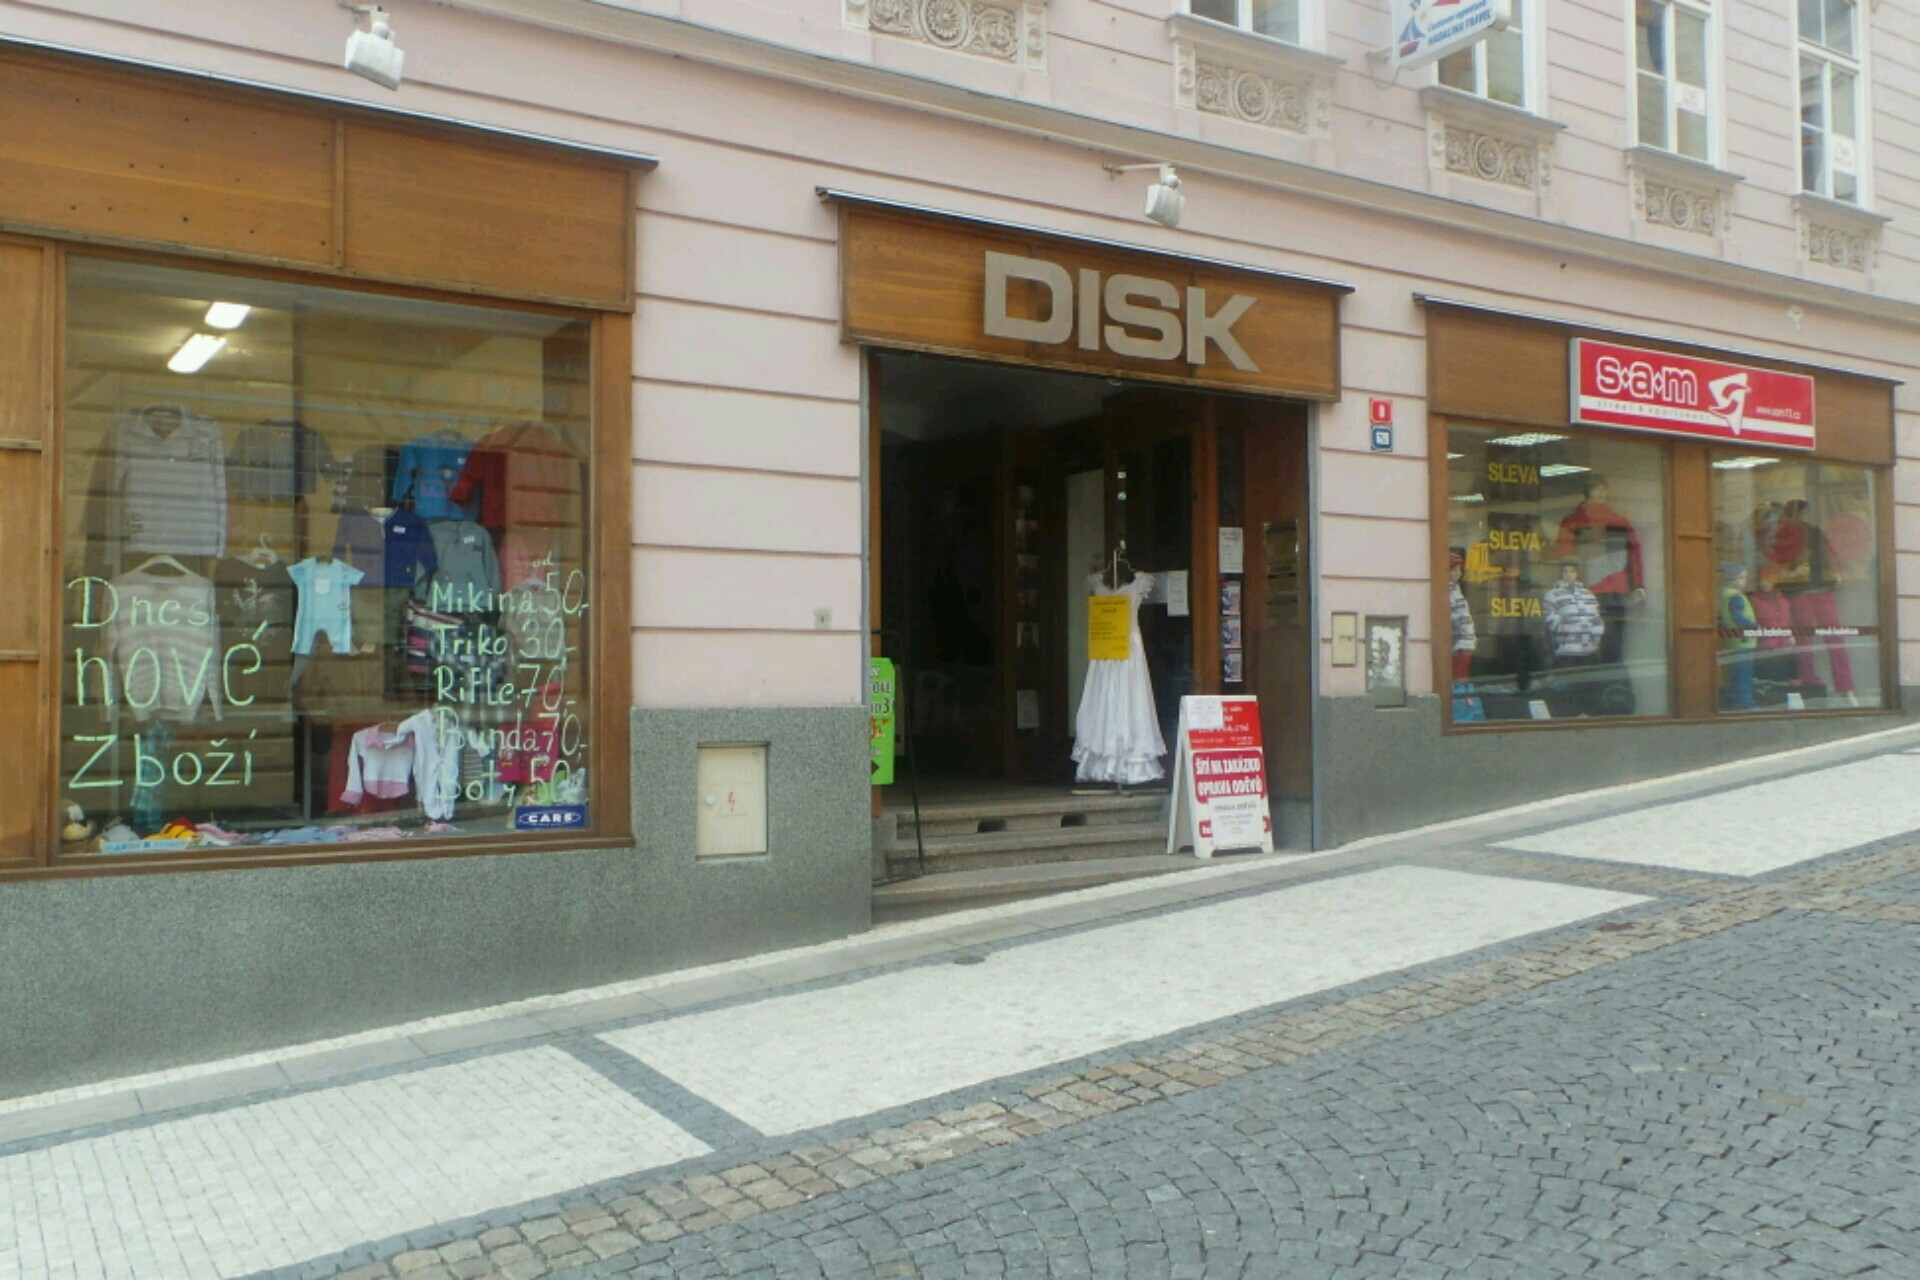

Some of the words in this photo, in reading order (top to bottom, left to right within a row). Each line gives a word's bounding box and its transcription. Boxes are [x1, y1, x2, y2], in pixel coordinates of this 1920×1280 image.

[984, 250, 1260, 373] DISK
[1488, 462, 1540, 485] SLEVA
[1489, 529, 1542, 552] SLEVA
[67, 576, 210, 628] Dnes
[432, 580, 537, 613] Mikina
[1490, 598, 1542, 617] SLEVA
[432, 624, 508, 656] Triko
[76, 620, 268, 708] nové
[435, 706, 541, 751] Bunda
[69, 728, 257, 788] Zboží
